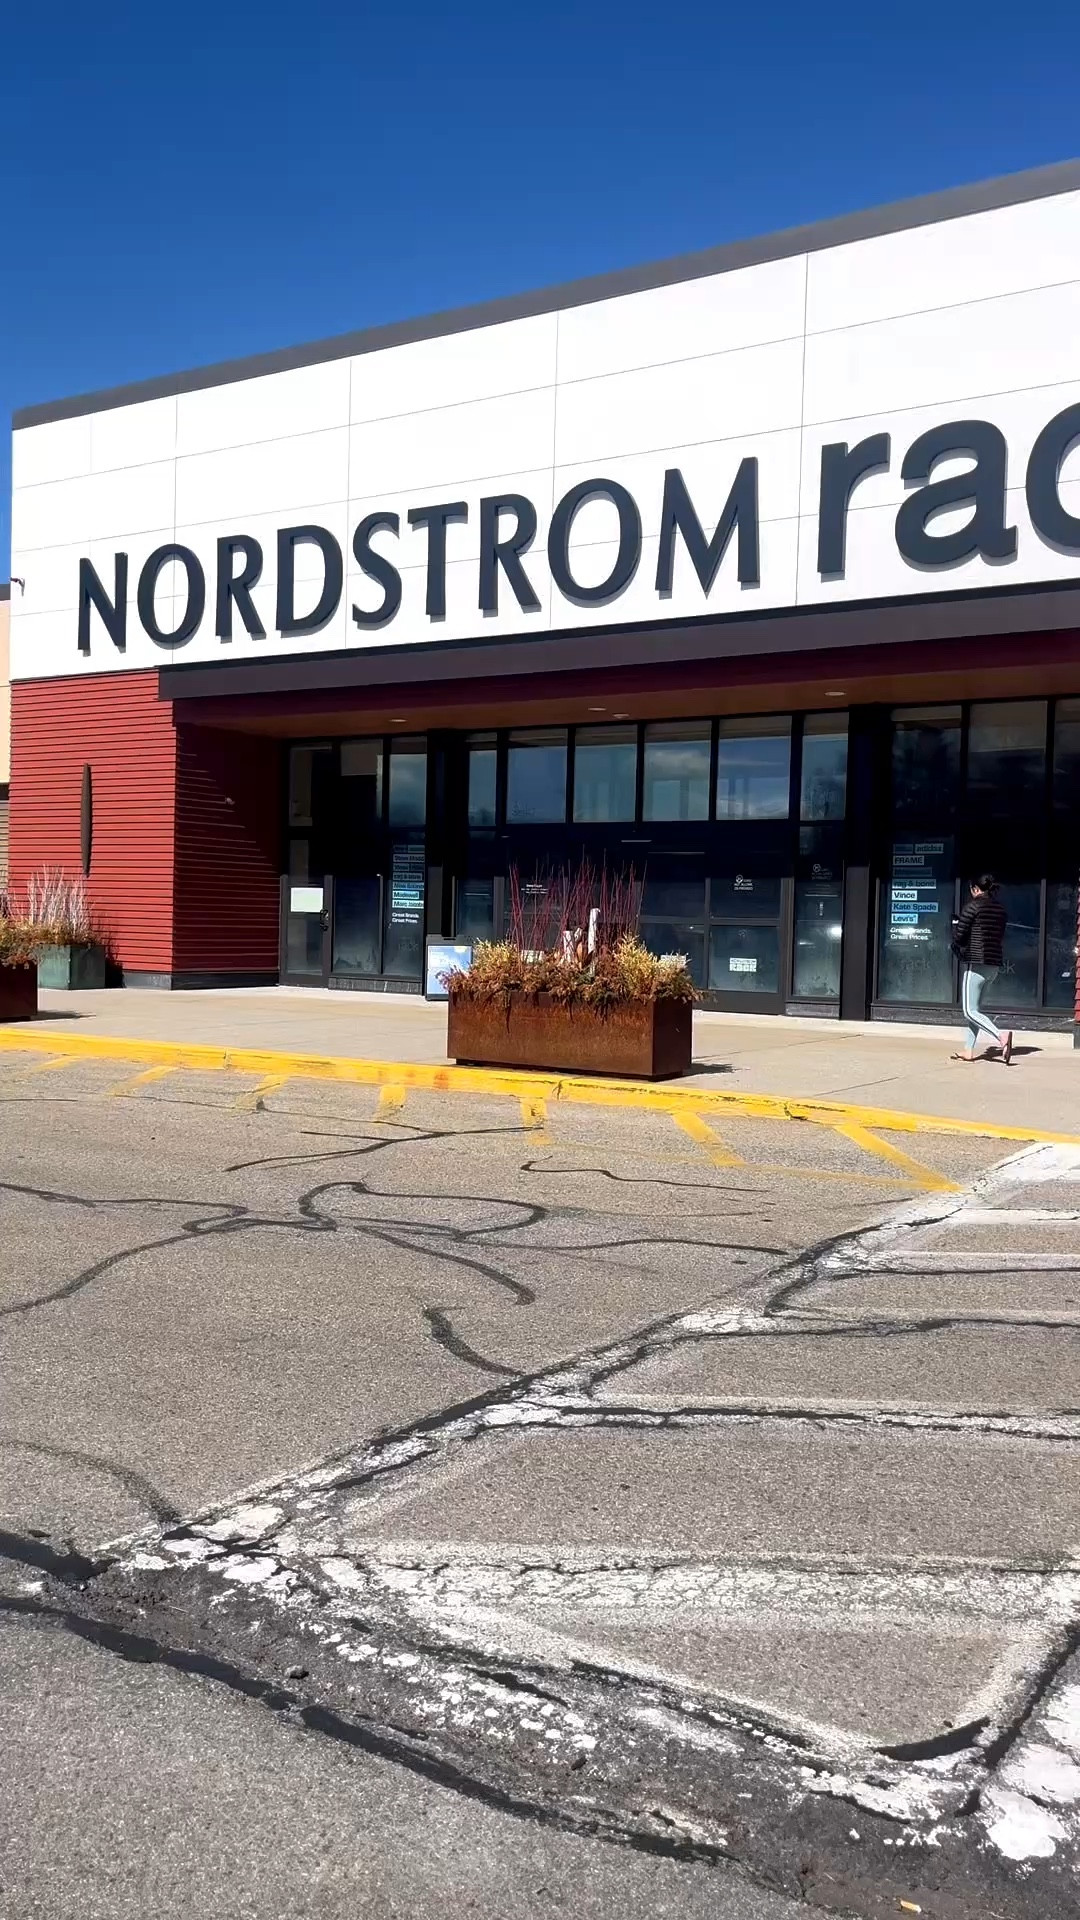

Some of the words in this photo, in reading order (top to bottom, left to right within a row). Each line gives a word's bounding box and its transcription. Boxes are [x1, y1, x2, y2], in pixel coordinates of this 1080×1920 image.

[78, 458, 760, 652] NORDSTROM
[894, 856, 923, 864] FRAME
[912, 903, 937, 912] Spade
